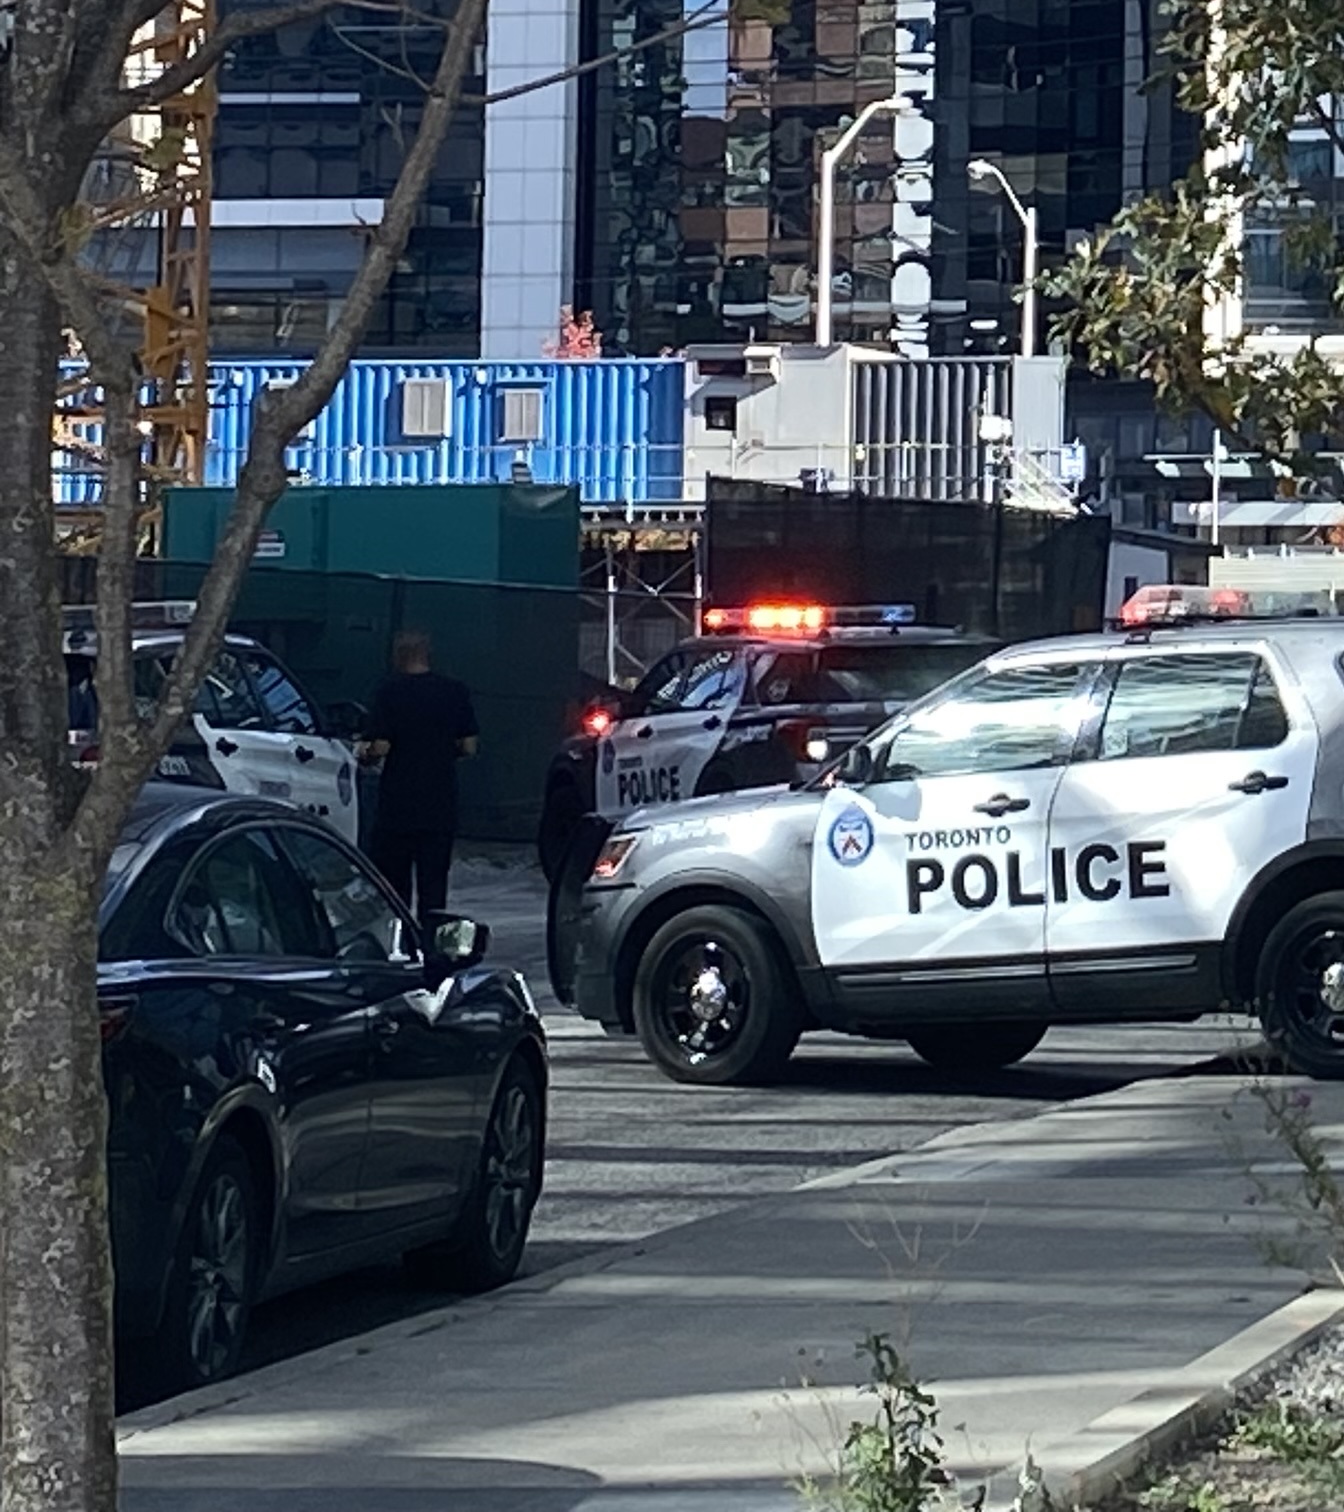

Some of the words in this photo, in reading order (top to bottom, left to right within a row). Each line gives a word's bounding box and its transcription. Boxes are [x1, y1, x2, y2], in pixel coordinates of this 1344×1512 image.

[618, 765, 680, 807] POLICE
[904, 825, 1012, 851] TORONTO
[906, 840, 1171, 914] POLICE
